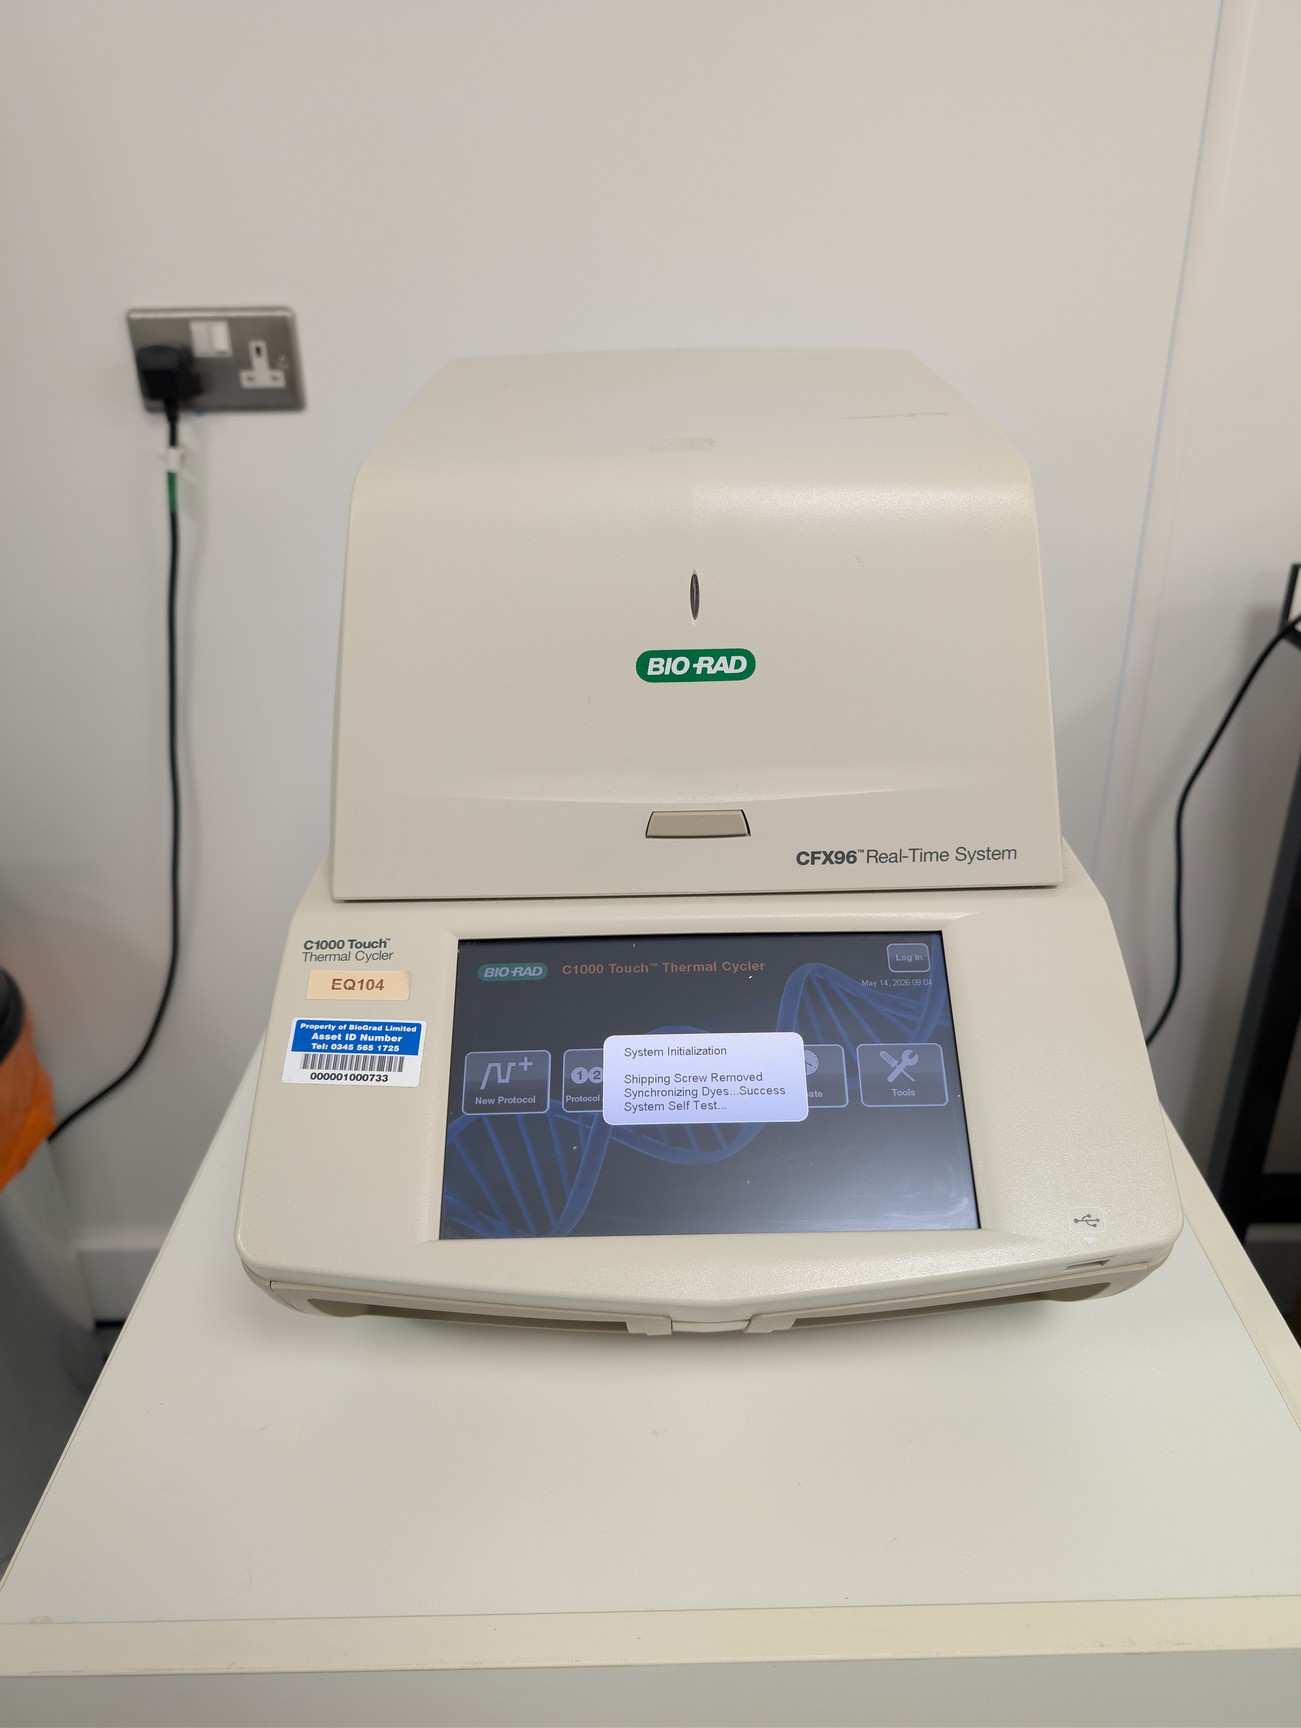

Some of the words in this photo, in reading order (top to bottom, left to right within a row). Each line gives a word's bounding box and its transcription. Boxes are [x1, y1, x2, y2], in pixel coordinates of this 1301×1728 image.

[866, 848, 949, 863] Real-Time
[955, 846, 1018, 865] System
[303, 939, 345, 951] C1000
[302, 951, 351, 963] Thermal
[355, 950, 394, 963] Cycler
[895, 953, 913, 963] Log
[914, 953, 923, 961] In
[562, 964, 604, 975] C1000
[662, 961, 717, 973] Thermal
[722, 961, 766, 973] Cycler
[331, 978, 385, 991] EQ104
[861, 979, 877, 988] May
[880, 979, 892, 987] 14,
[892, 978, 911, 987] 2026
[300, 1022, 336, 1032] Property
[349, 1024, 383, 1032] BioGrad
[311, 1032, 342, 1041] Asset
[345, 1033, 356, 1041] ID
[360, 1034, 403, 1042] Number
[311, 1042, 328, 1050] Tel:
[331, 1043, 354, 1051] 0345
[377, 1044, 400, 1052] 1725
[624, 1047, 664, 1059] System
[667, 1046, 727, 1056] Initialization
[310, 1072, 388, 1082] 000001000733
[624, 1074, 671, 1086] Shipping
[673, 1073, 708, 1083] Screw
[710, 1072, 763, 1082] Removed
[624, 1088, 698, 1100] Synchronizing
[891, 1088, 916, 1097] Tools
[475, 1096, 496, 1105] New
[497, 1095, 536, 1104] Protocol
[565, 1095, 600, 1103] Protocol
[624, 1101, 665, 1114] System
[668, 1100, 690, 1111] Self
[693, 1100, 727, 1110] Test...
